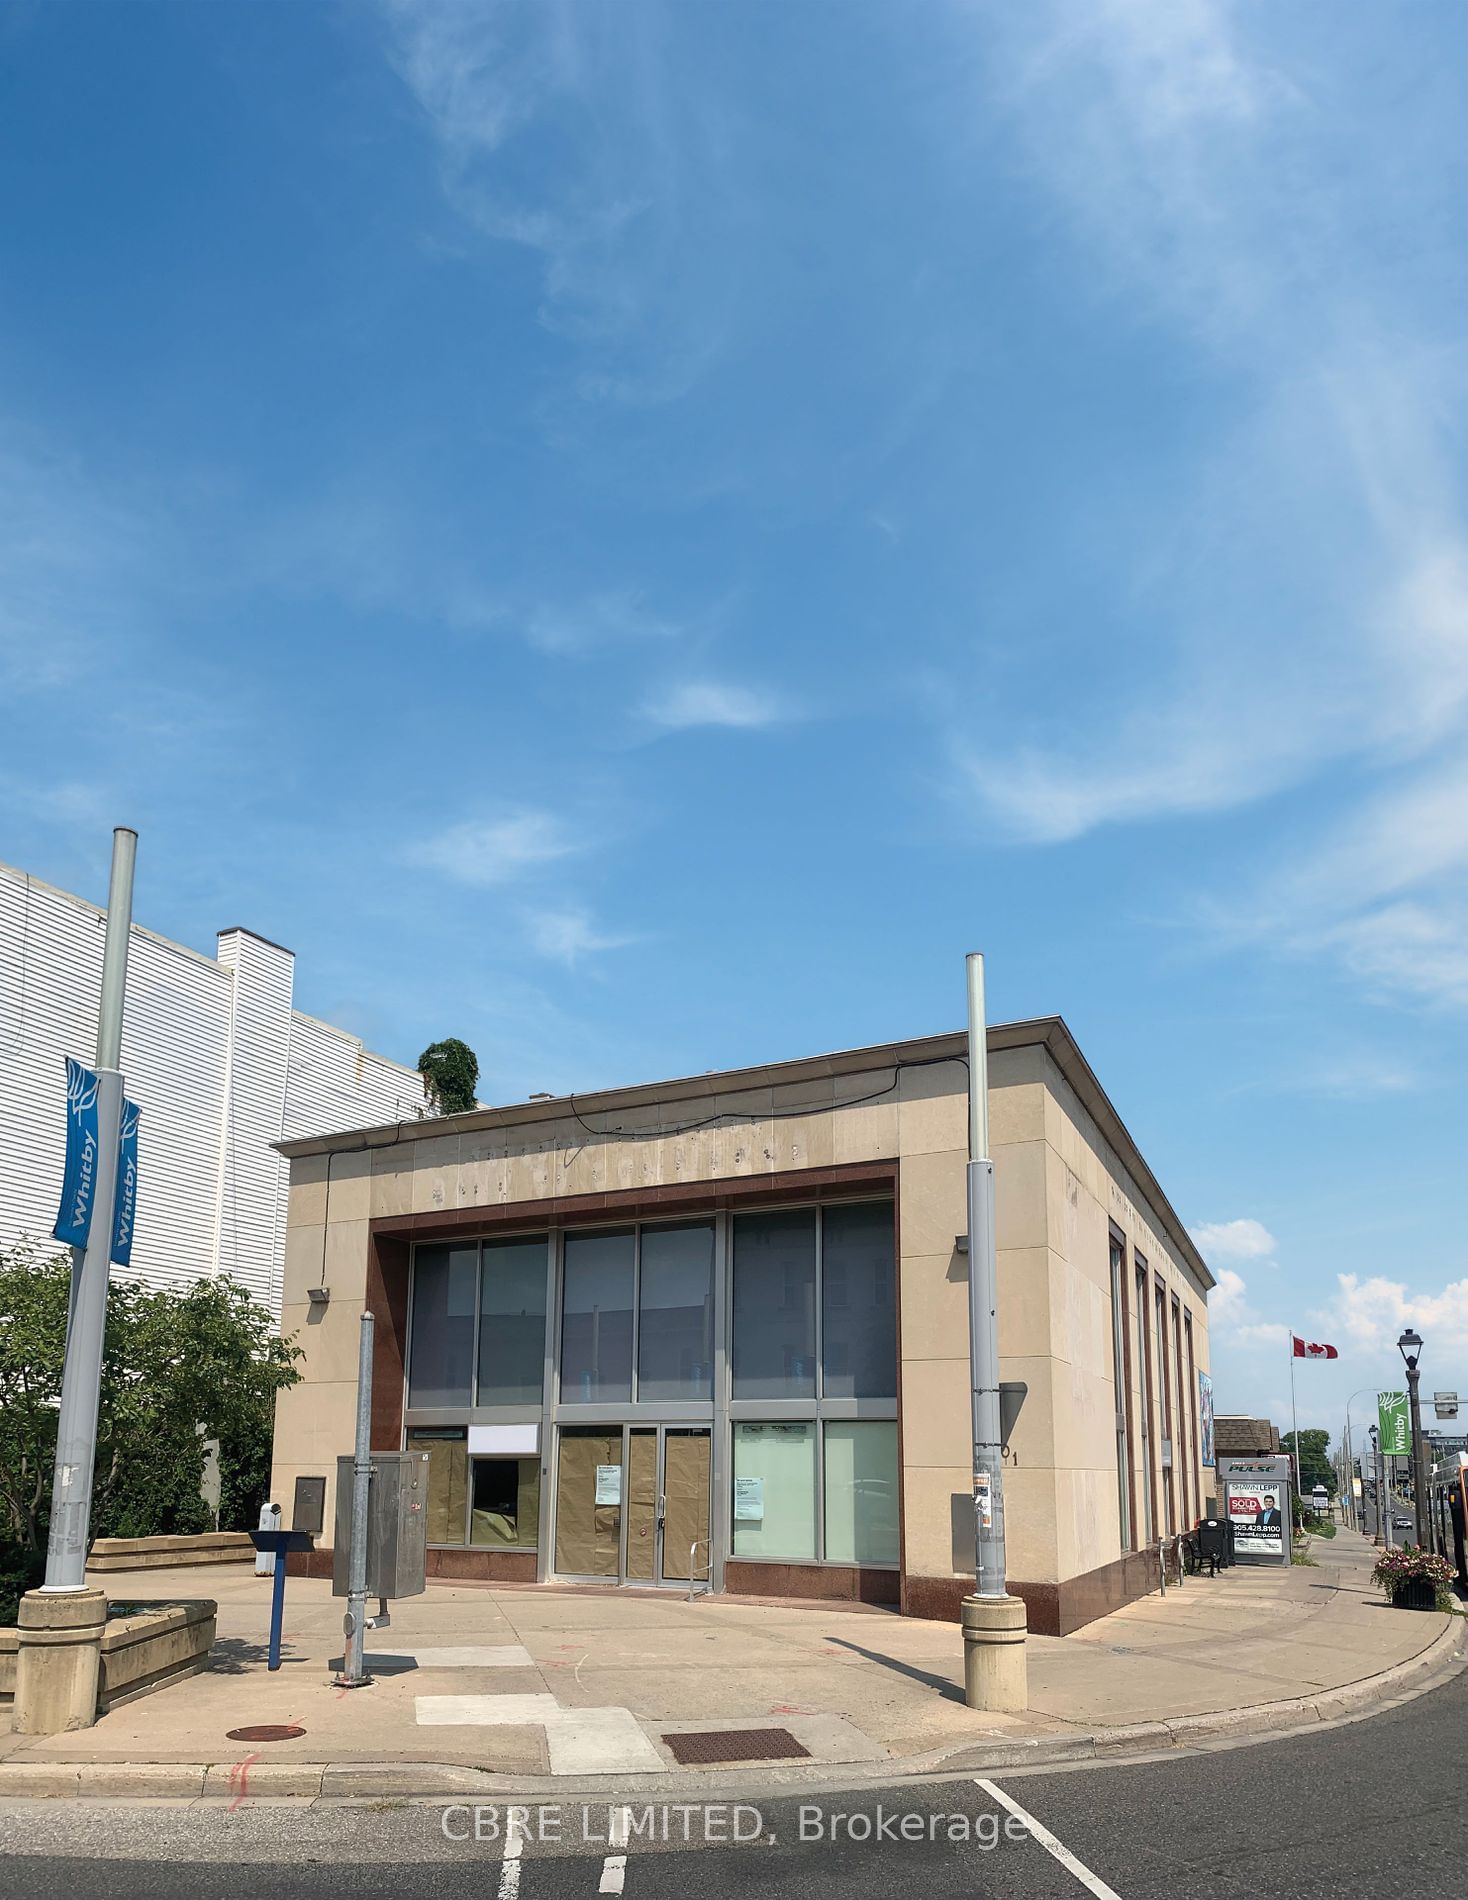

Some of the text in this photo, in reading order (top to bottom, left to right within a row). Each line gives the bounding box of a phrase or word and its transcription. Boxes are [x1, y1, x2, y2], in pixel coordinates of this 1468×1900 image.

[73, 1129, 97, 1227] Whitby
[118, 1156, 136, 1247] Whitby
[1395, 1413, 1407, 1450] Whitby
[1231, 1499, 1257, 1508] SOLD
